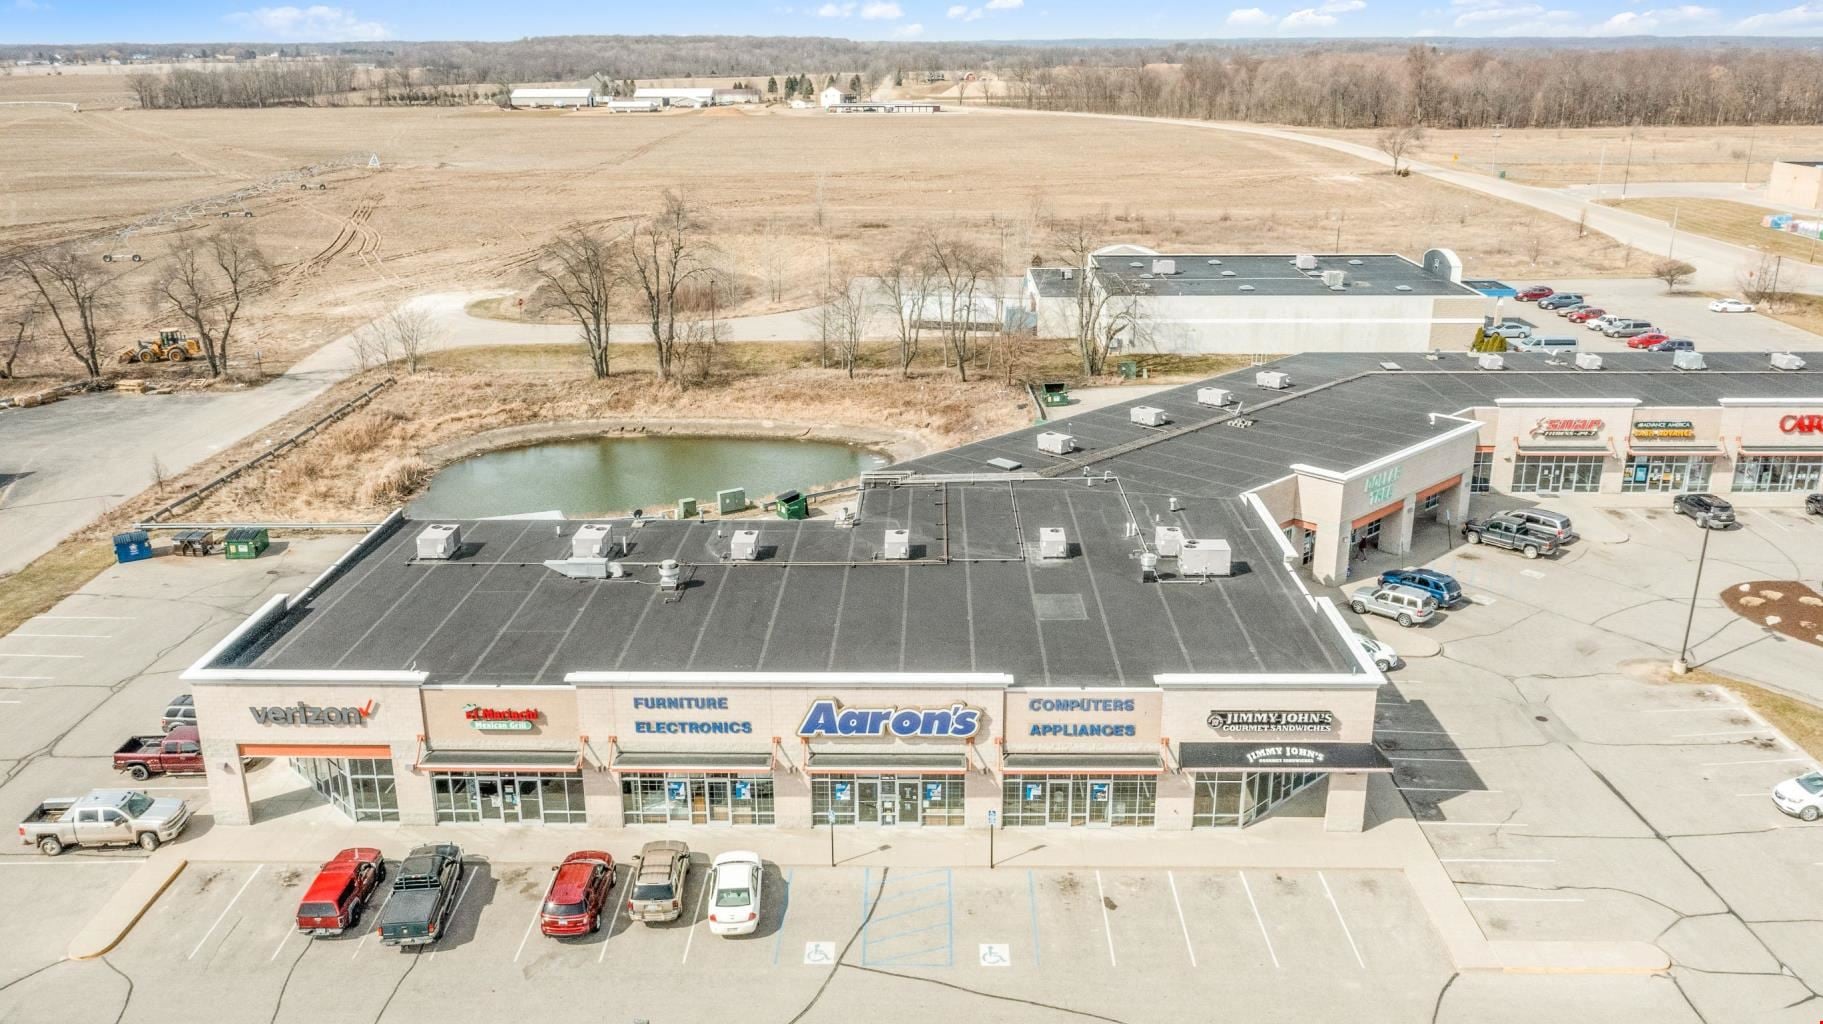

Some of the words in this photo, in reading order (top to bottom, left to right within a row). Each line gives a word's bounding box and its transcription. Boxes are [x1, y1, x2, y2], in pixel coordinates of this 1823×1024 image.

[633, 697, 729, 710] FURNITURE
[1028, 698, 1135, 712] COMPUTERS
[249, 701, 362, 725] verizon
[799, 702, 979, 736] Aaron's
[1226, 713, 1278, 724] JIMMY
[1281, 713, 1333, 724] JOHN'S
[475, 721, 508, 729] Mexican
[635, 721, 753, 734] ELECTRONICS
[1029, 724, 1136, 737] APPLIANCES
[1222, 724, 1269, 732] GOURMET
[1270, 724, 1332, 732] SANDWICHES
[1246, 747, 1283, 763] JIMMY
[1285, 747, 1325, 761] JOHN'S
